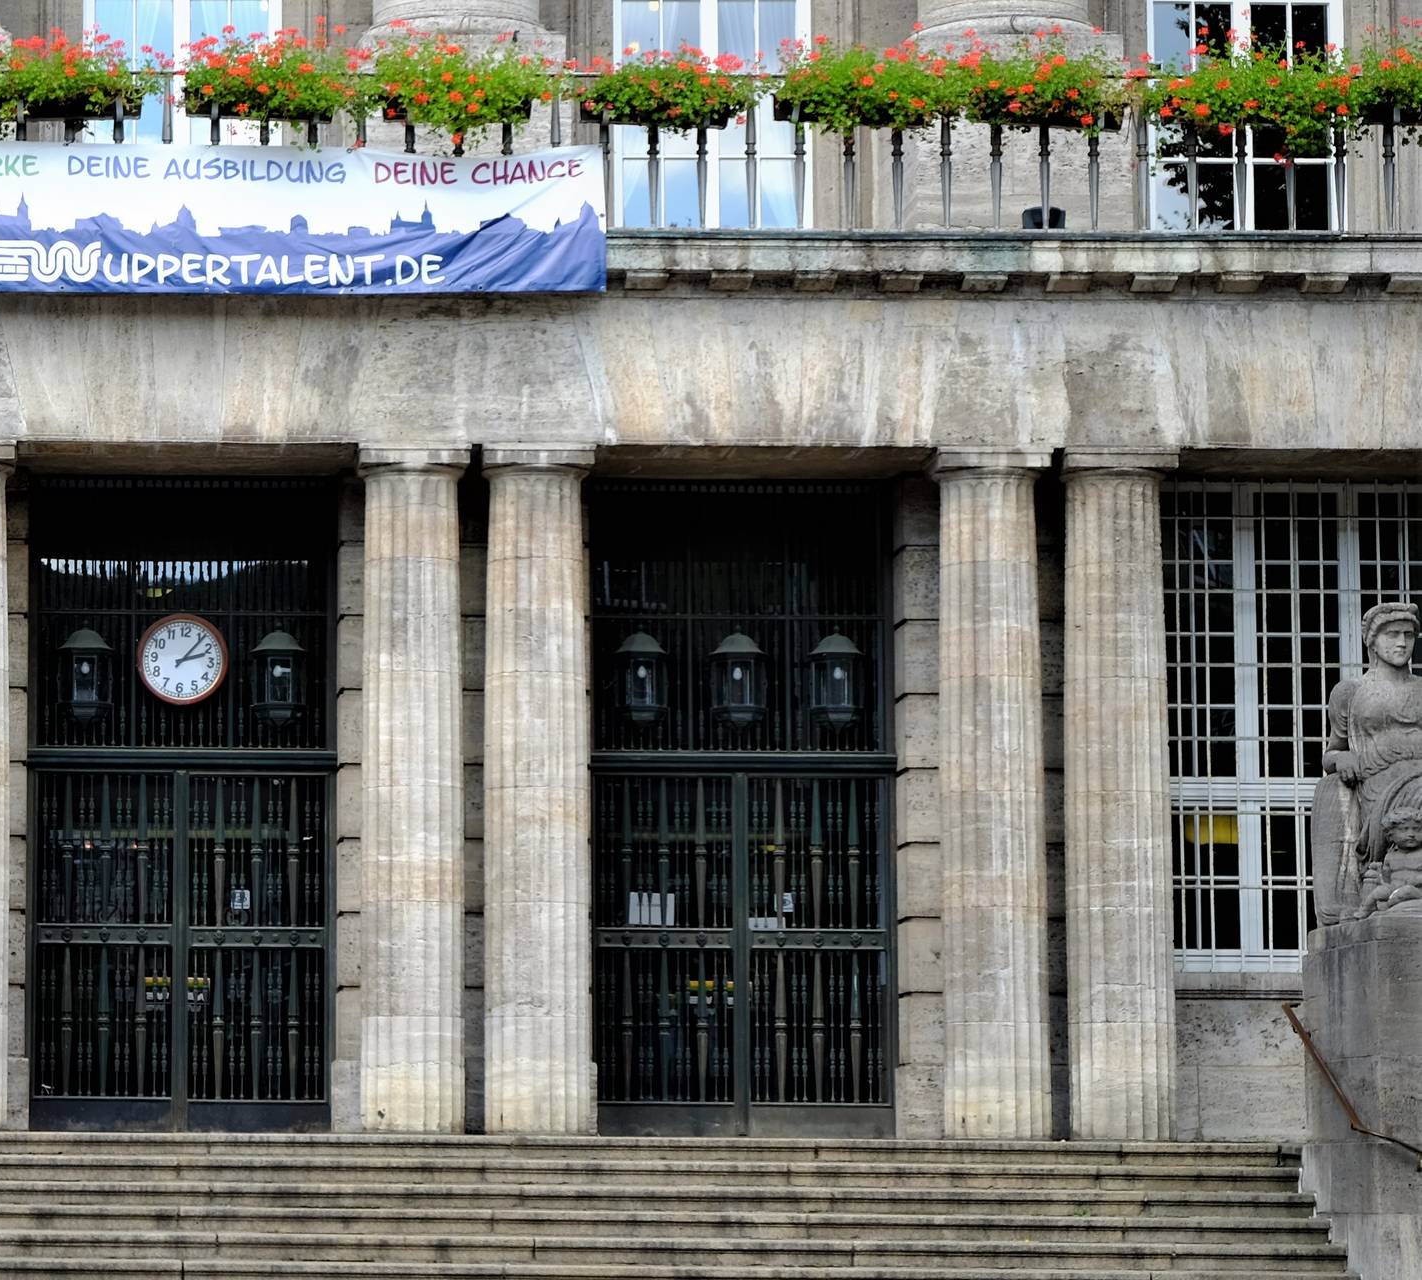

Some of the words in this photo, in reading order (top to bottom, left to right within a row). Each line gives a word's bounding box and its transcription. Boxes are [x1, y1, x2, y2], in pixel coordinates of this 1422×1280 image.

[67, 155, 150, 179] DEINE
[163, 157, 347, 184] AUSBILDUNG
[375, 161, 458, 186] DEINE
[471, 159, 585, 186] CHANCE
[180, 627, 192, 638] 12
[154, 638, 166, 650] 10
[205, 643, 212, 654] 2
[150, 652, 158, 662] 9
[206, 657, 214, 668] 3
[152, 665, 160, 677] 8
[163, 677, 170, 687] 7
[201, 672, 209, 682] 4
[175, 682, 183, 693] 6
[191, 680, 198, 691] 5
